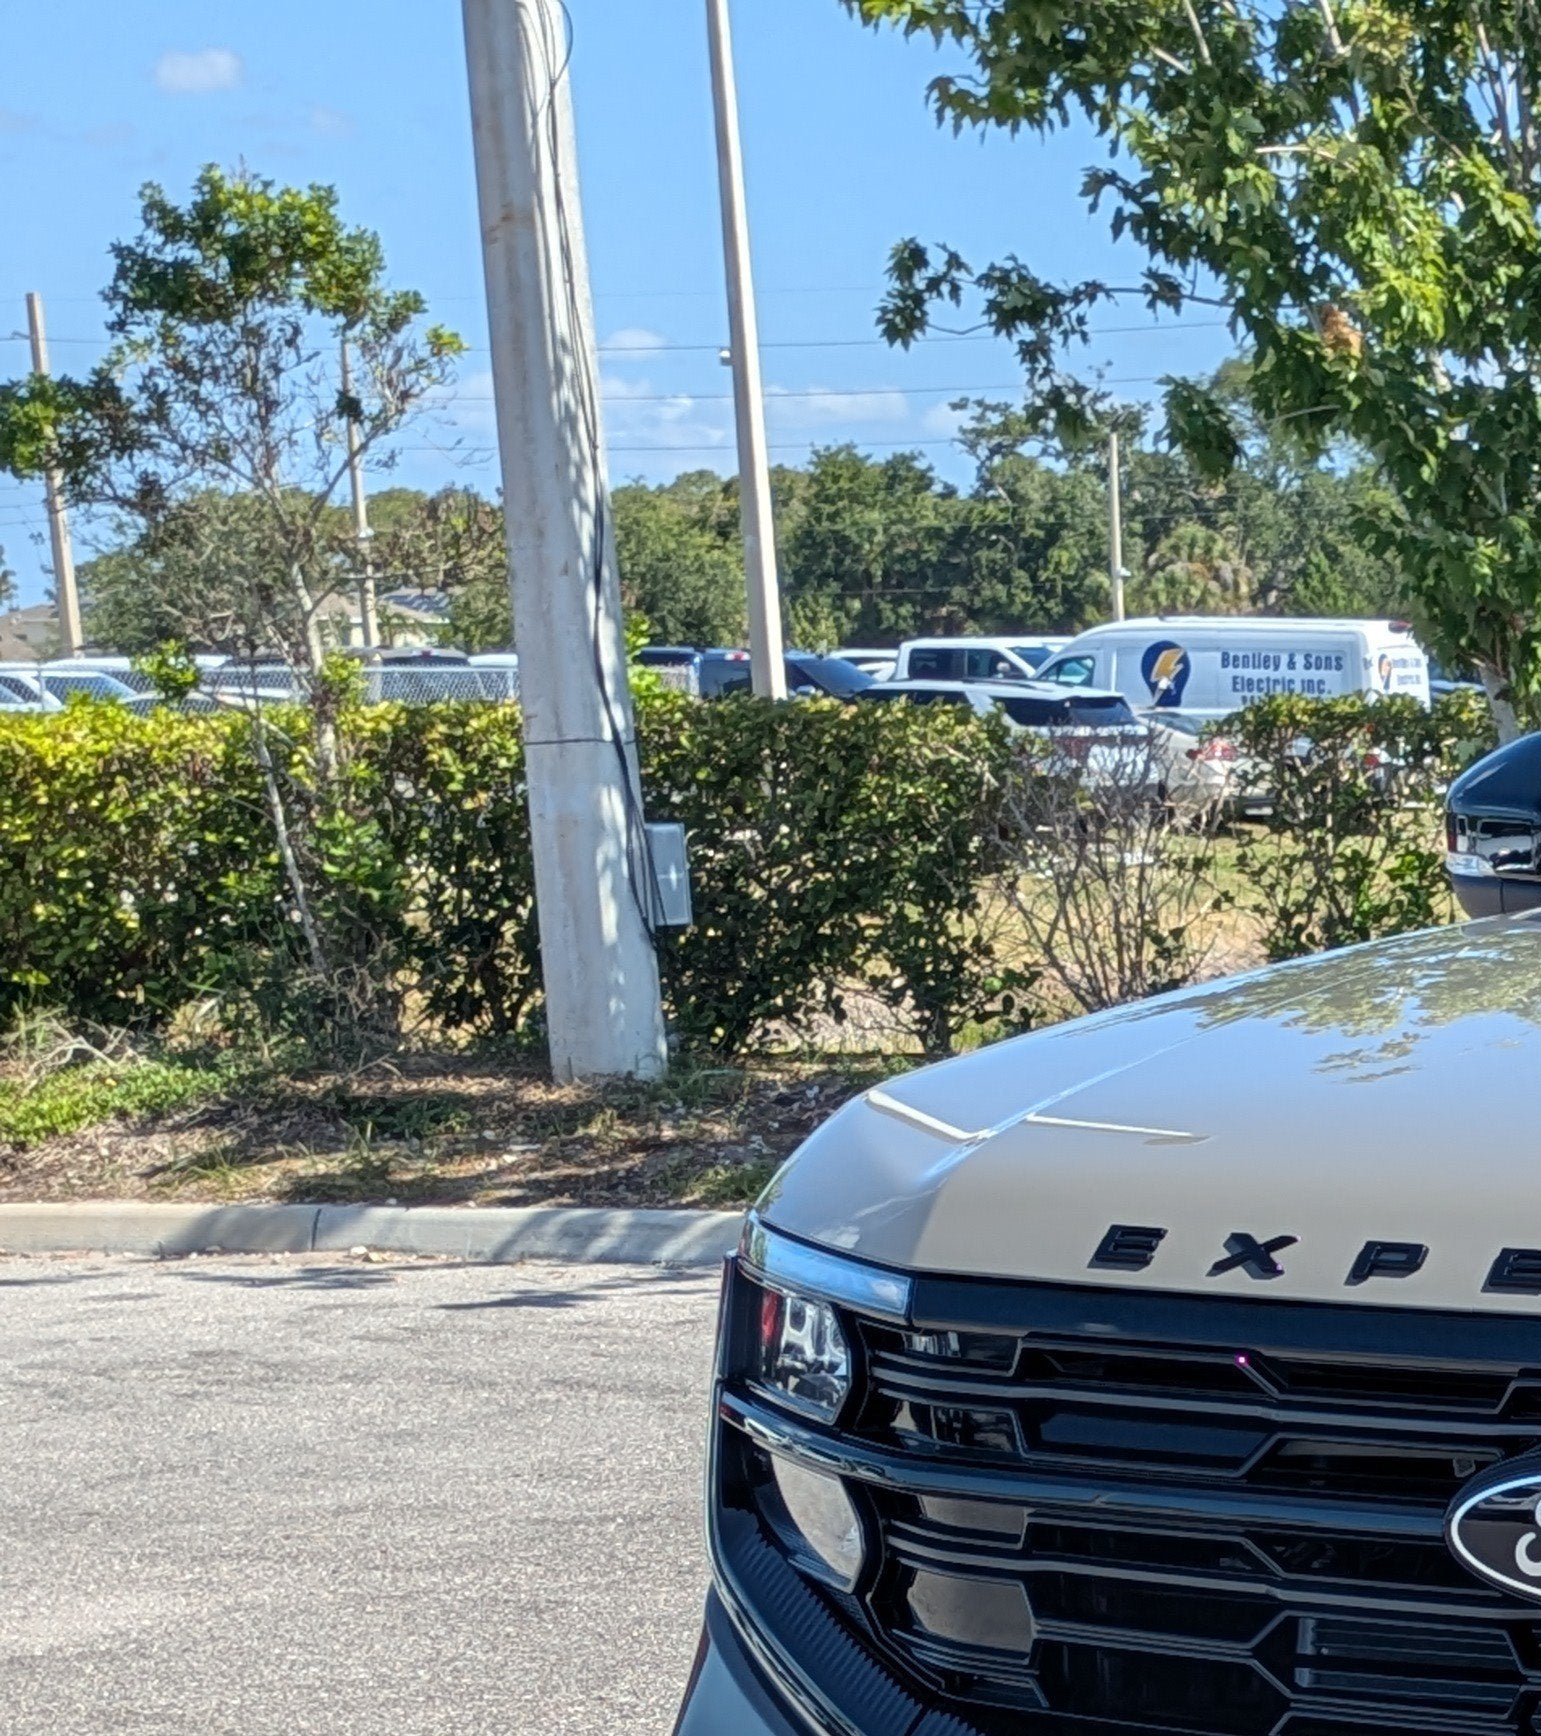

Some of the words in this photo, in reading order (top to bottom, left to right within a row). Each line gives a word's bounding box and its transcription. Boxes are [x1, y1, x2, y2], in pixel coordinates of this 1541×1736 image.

[1287, 652, 1297, 670] &
[1303, 653, 1343, 671] Sons
[1232, 675, 1295, 693] Electric
